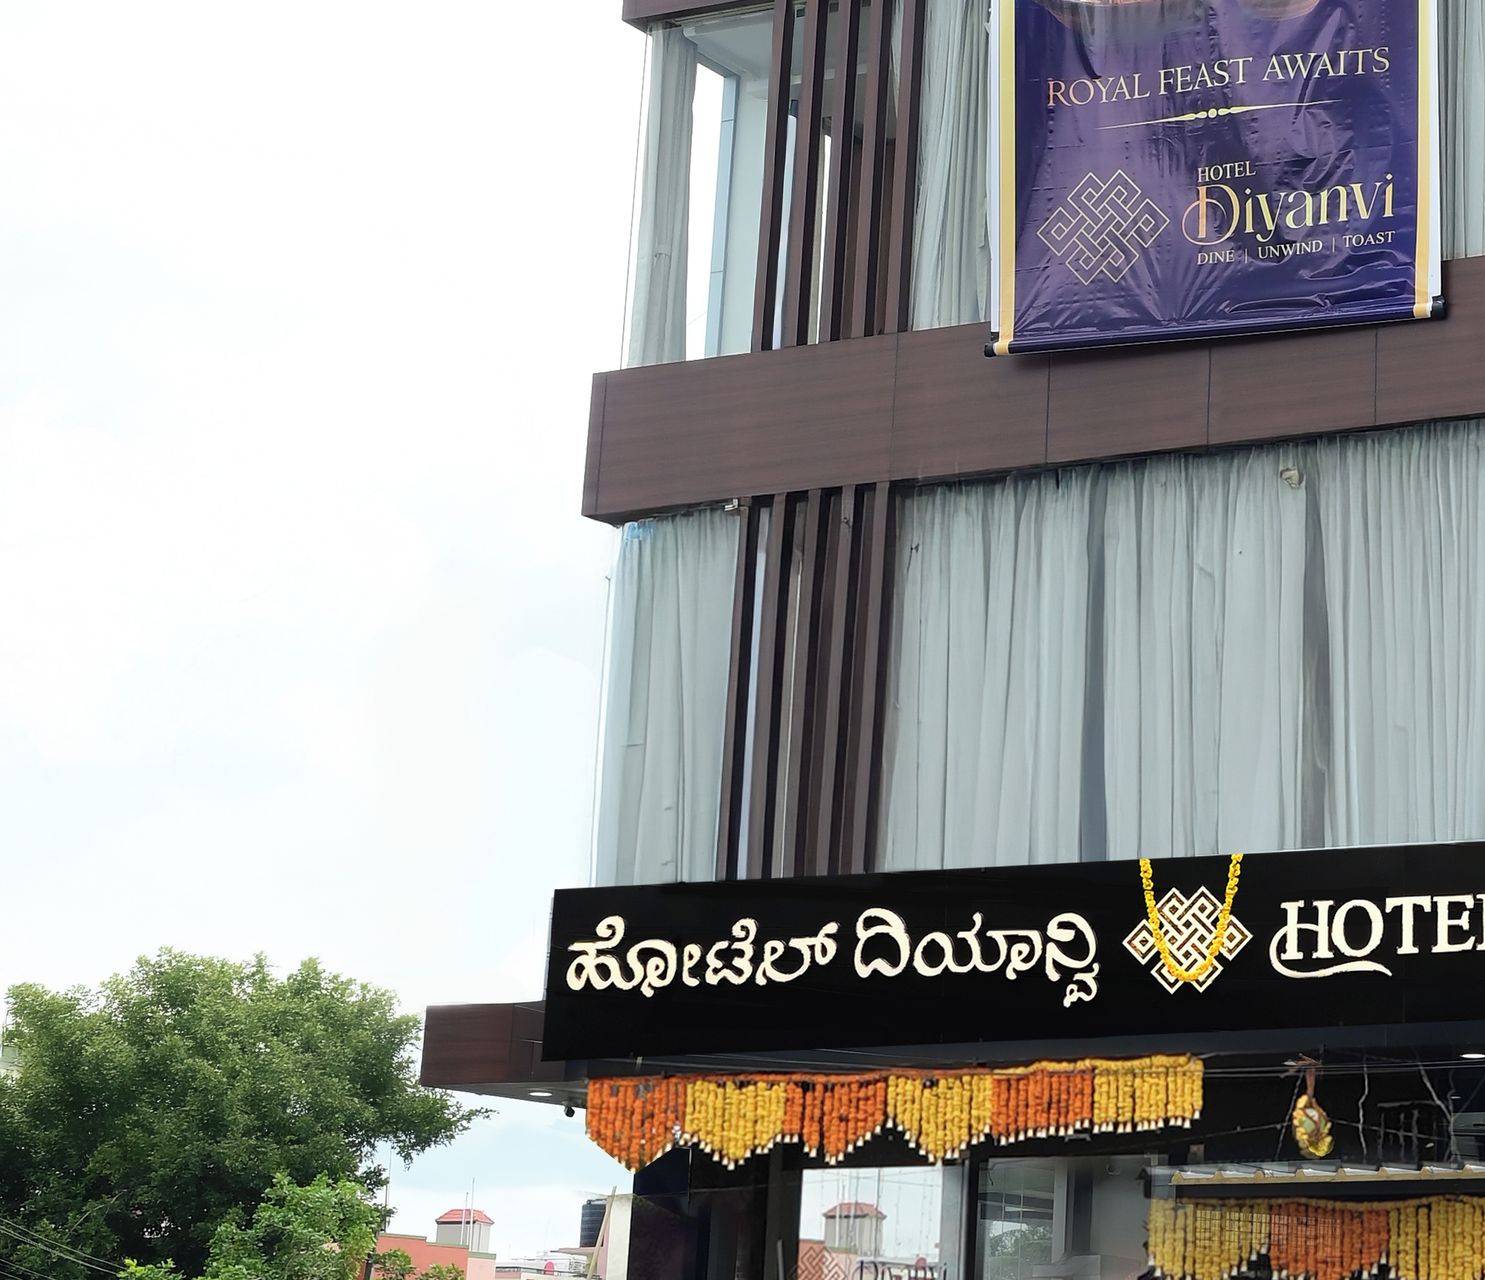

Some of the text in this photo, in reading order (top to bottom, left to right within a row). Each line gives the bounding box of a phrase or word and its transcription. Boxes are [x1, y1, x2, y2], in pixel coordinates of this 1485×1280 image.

[1048, 47, 1390, 107] ROYAL FEAST AWAITS
[1197, 160, 1256, 182] HOTEL
[1182, 173, 1394, 245] Diyanvi
[1197, 231, 1395, 265] DINE UNWIND TOAST
[566, 907, 1100, 1008] ಹೋಟೆಲ್ ದಿಯಾನ್ವಿ
